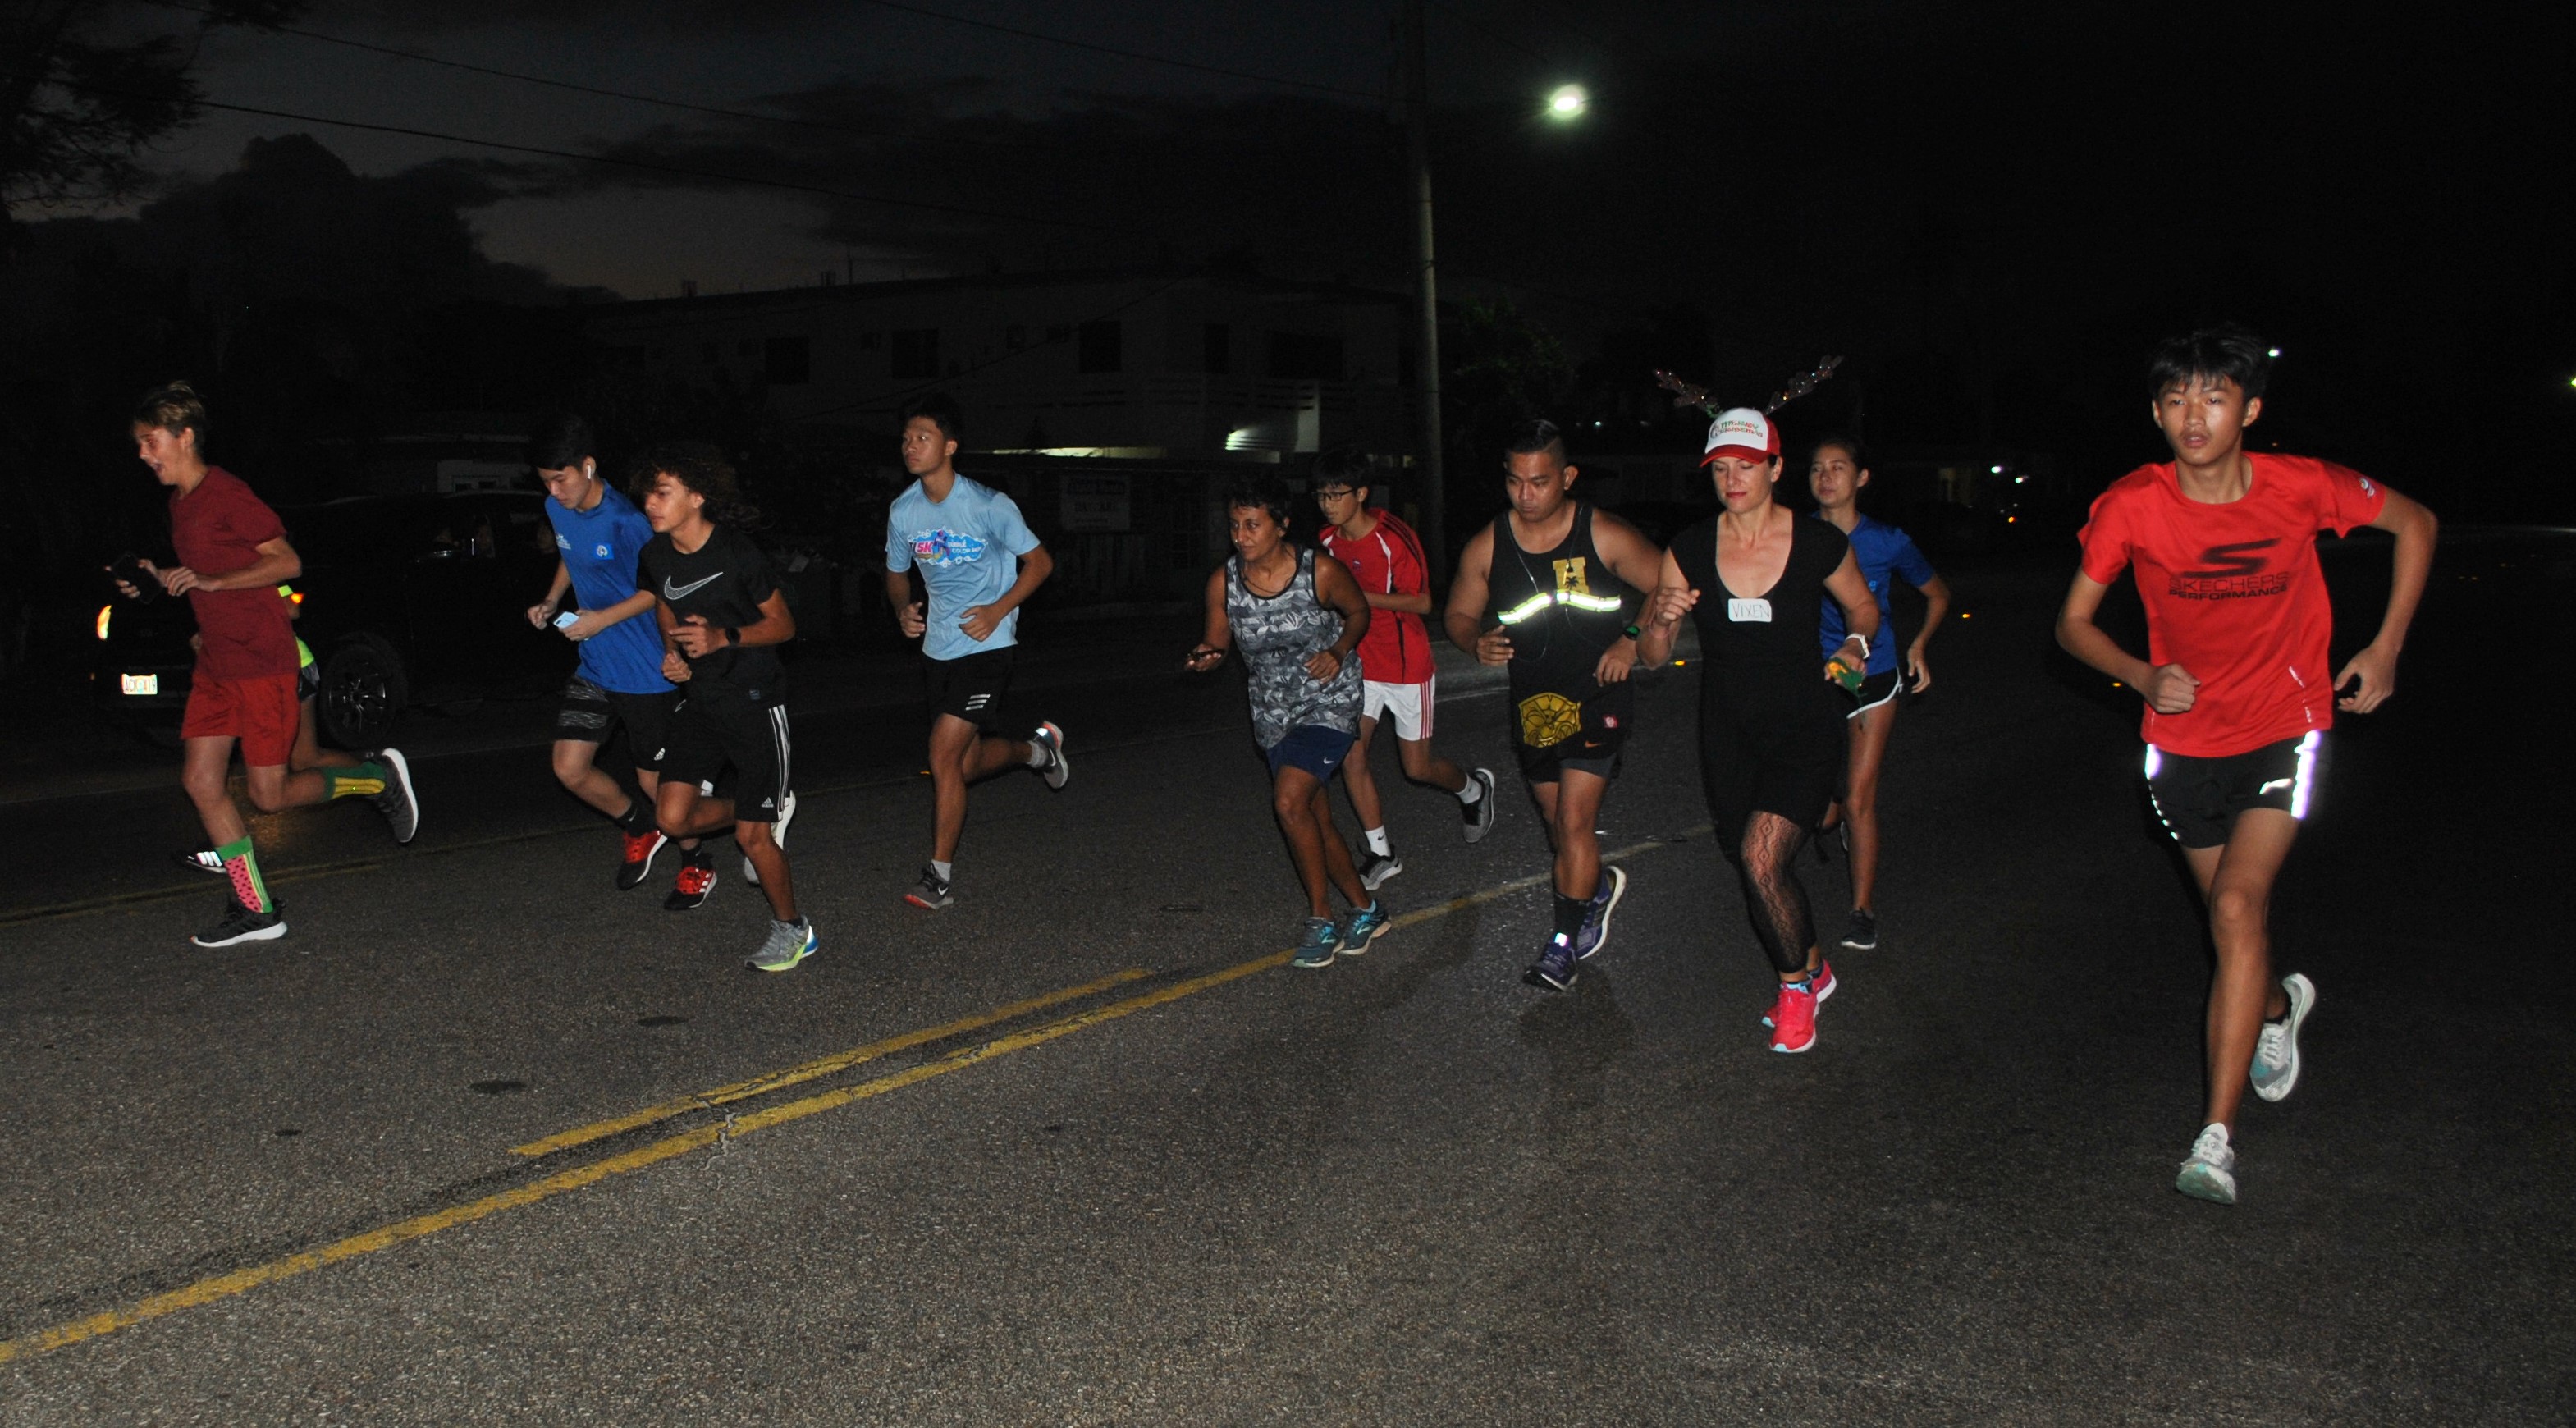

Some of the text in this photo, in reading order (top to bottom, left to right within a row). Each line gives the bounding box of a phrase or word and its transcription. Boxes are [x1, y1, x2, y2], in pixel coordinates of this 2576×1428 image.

[917, 541, 934, 553] 5K
[2169, 571, 2290, 591] SKECHERS
[2169, 584, 2288, 601] PERFORMANCE
[1732, 602, 1770, 618] VIXEN
